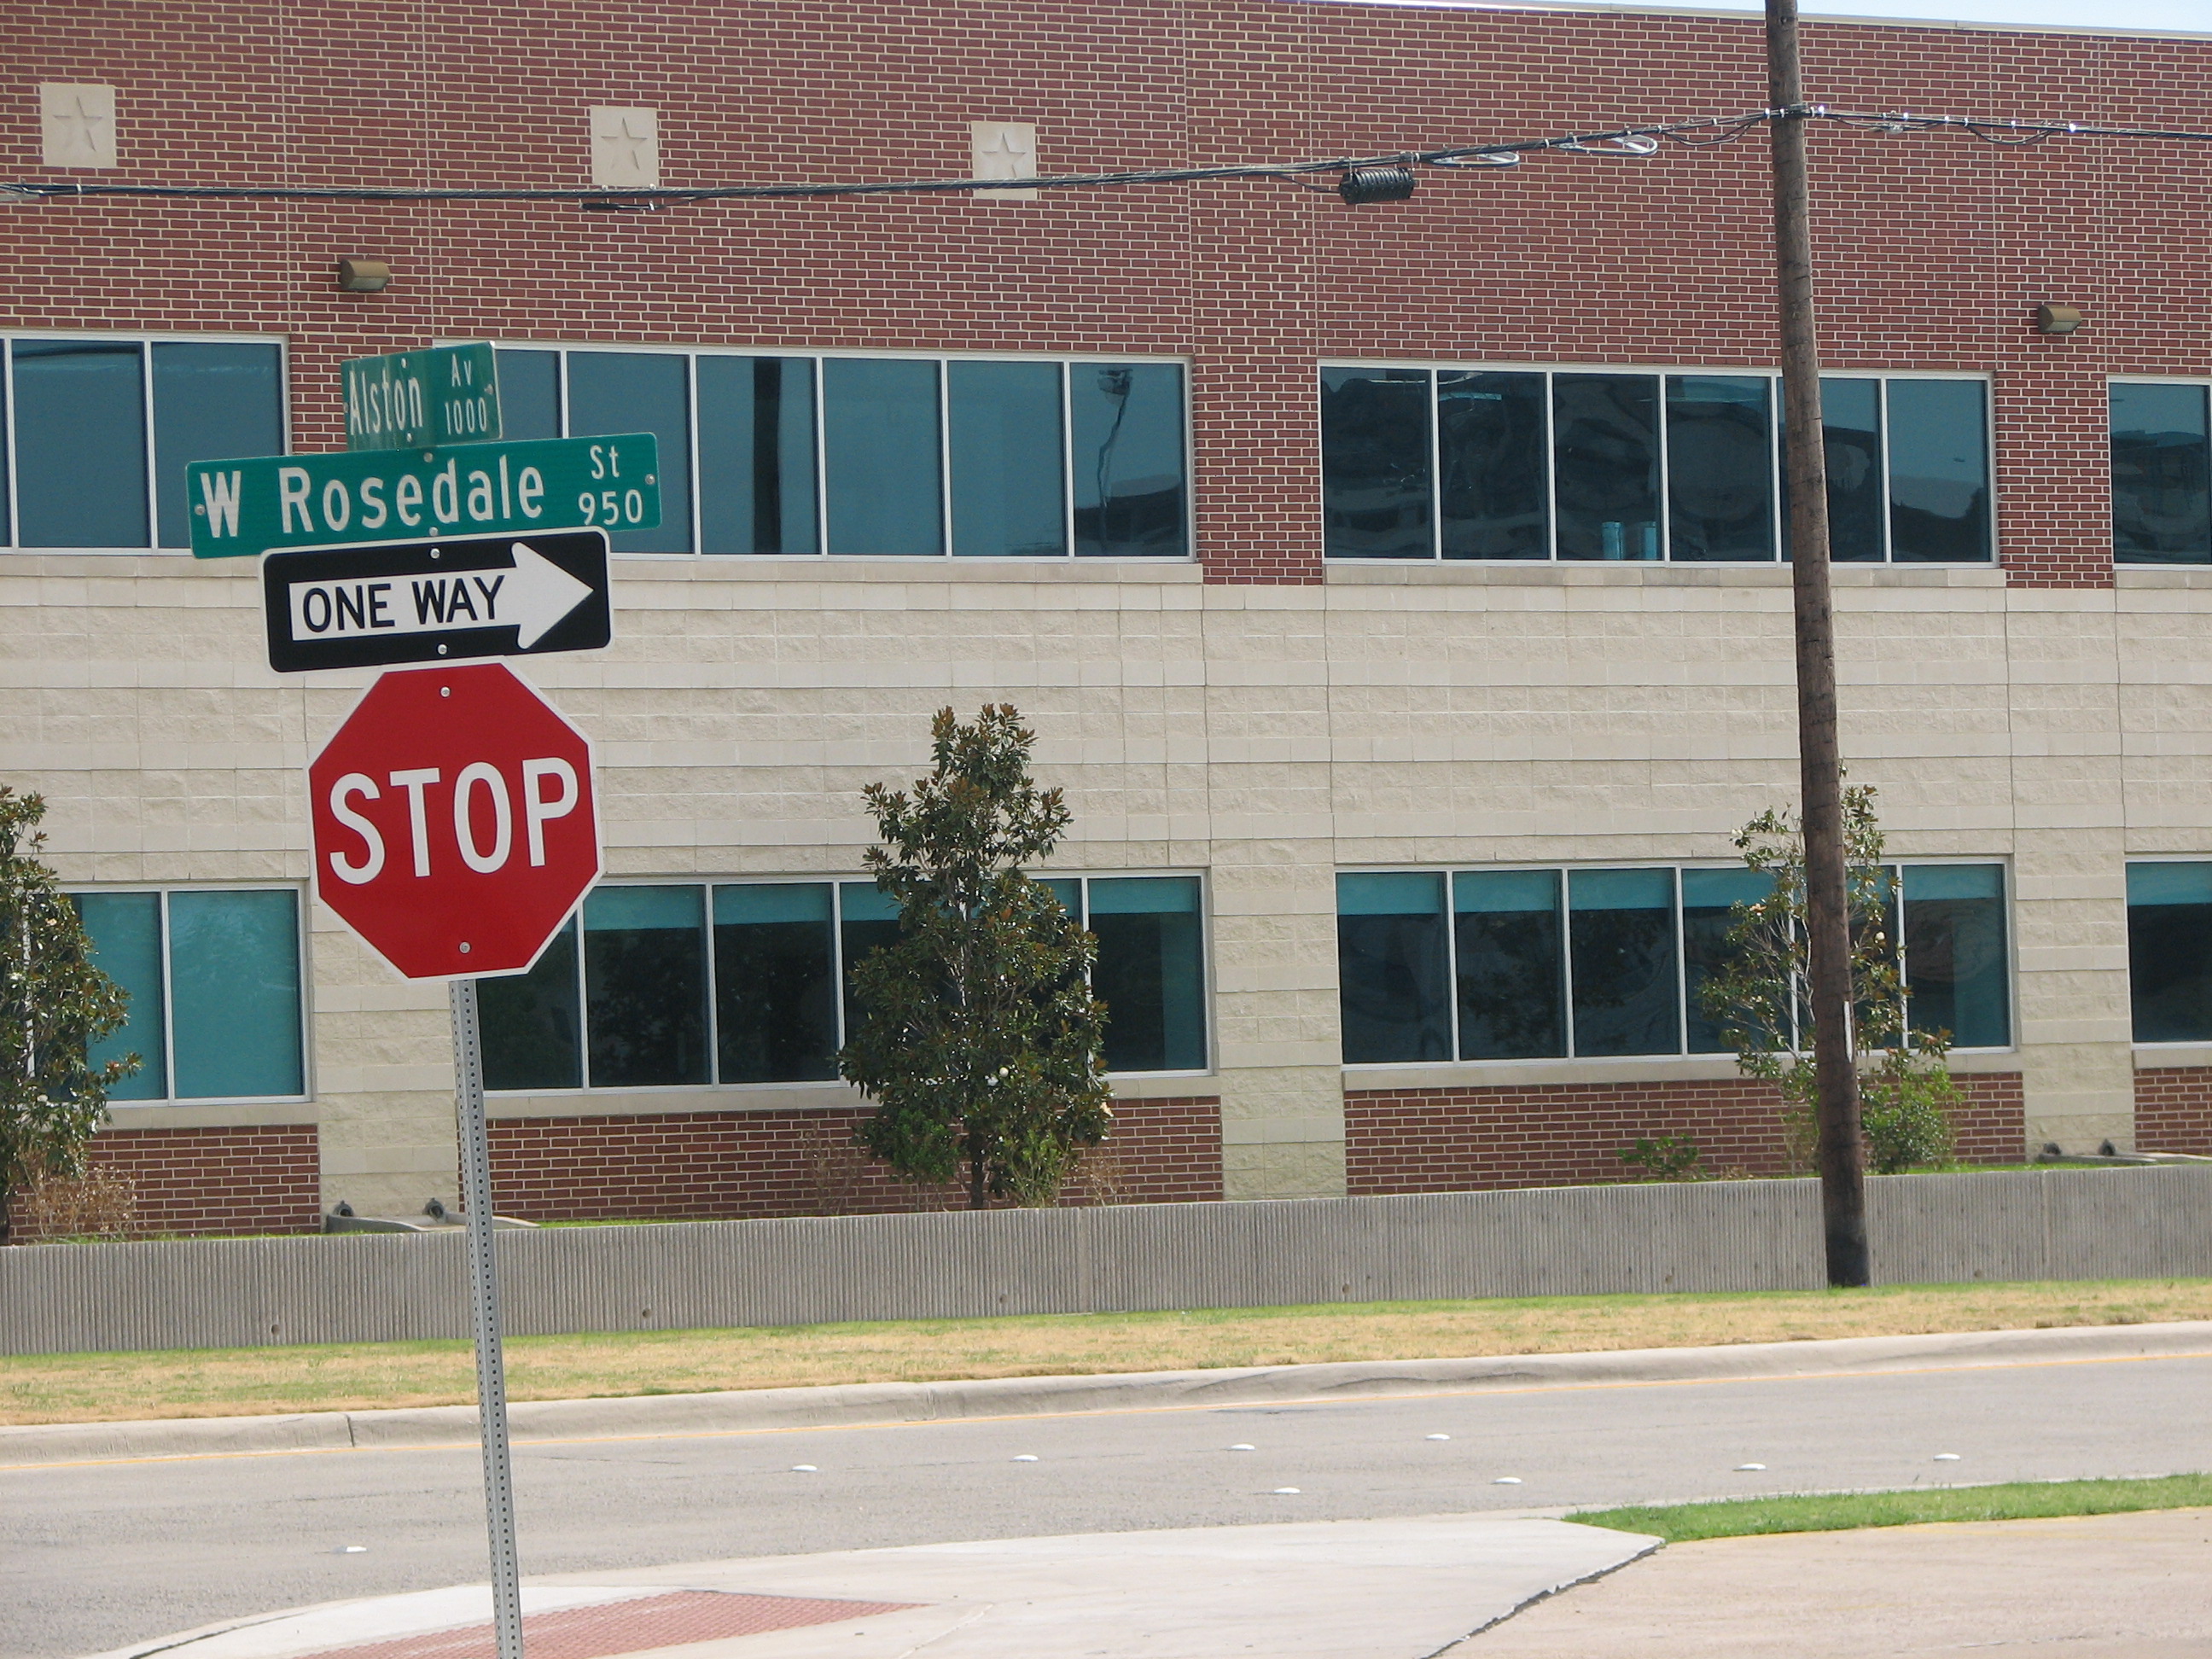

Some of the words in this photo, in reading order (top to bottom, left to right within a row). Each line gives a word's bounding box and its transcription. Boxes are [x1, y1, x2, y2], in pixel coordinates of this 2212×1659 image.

[451, 353, 472, 387] Av
[349, 369, 423, 435] Alston
[445, 398, 487, 434] 1000
[590, 445, 620, 480] St
[200, 470, 242, 538] W
[278, 454, 544, 534] Rosedale
[578, 489, 643, 526] 950
[303, 583, 395, 632] ONE
[411, 575, 505, 625] WAY
[329, 757, 579, 885] STOP
